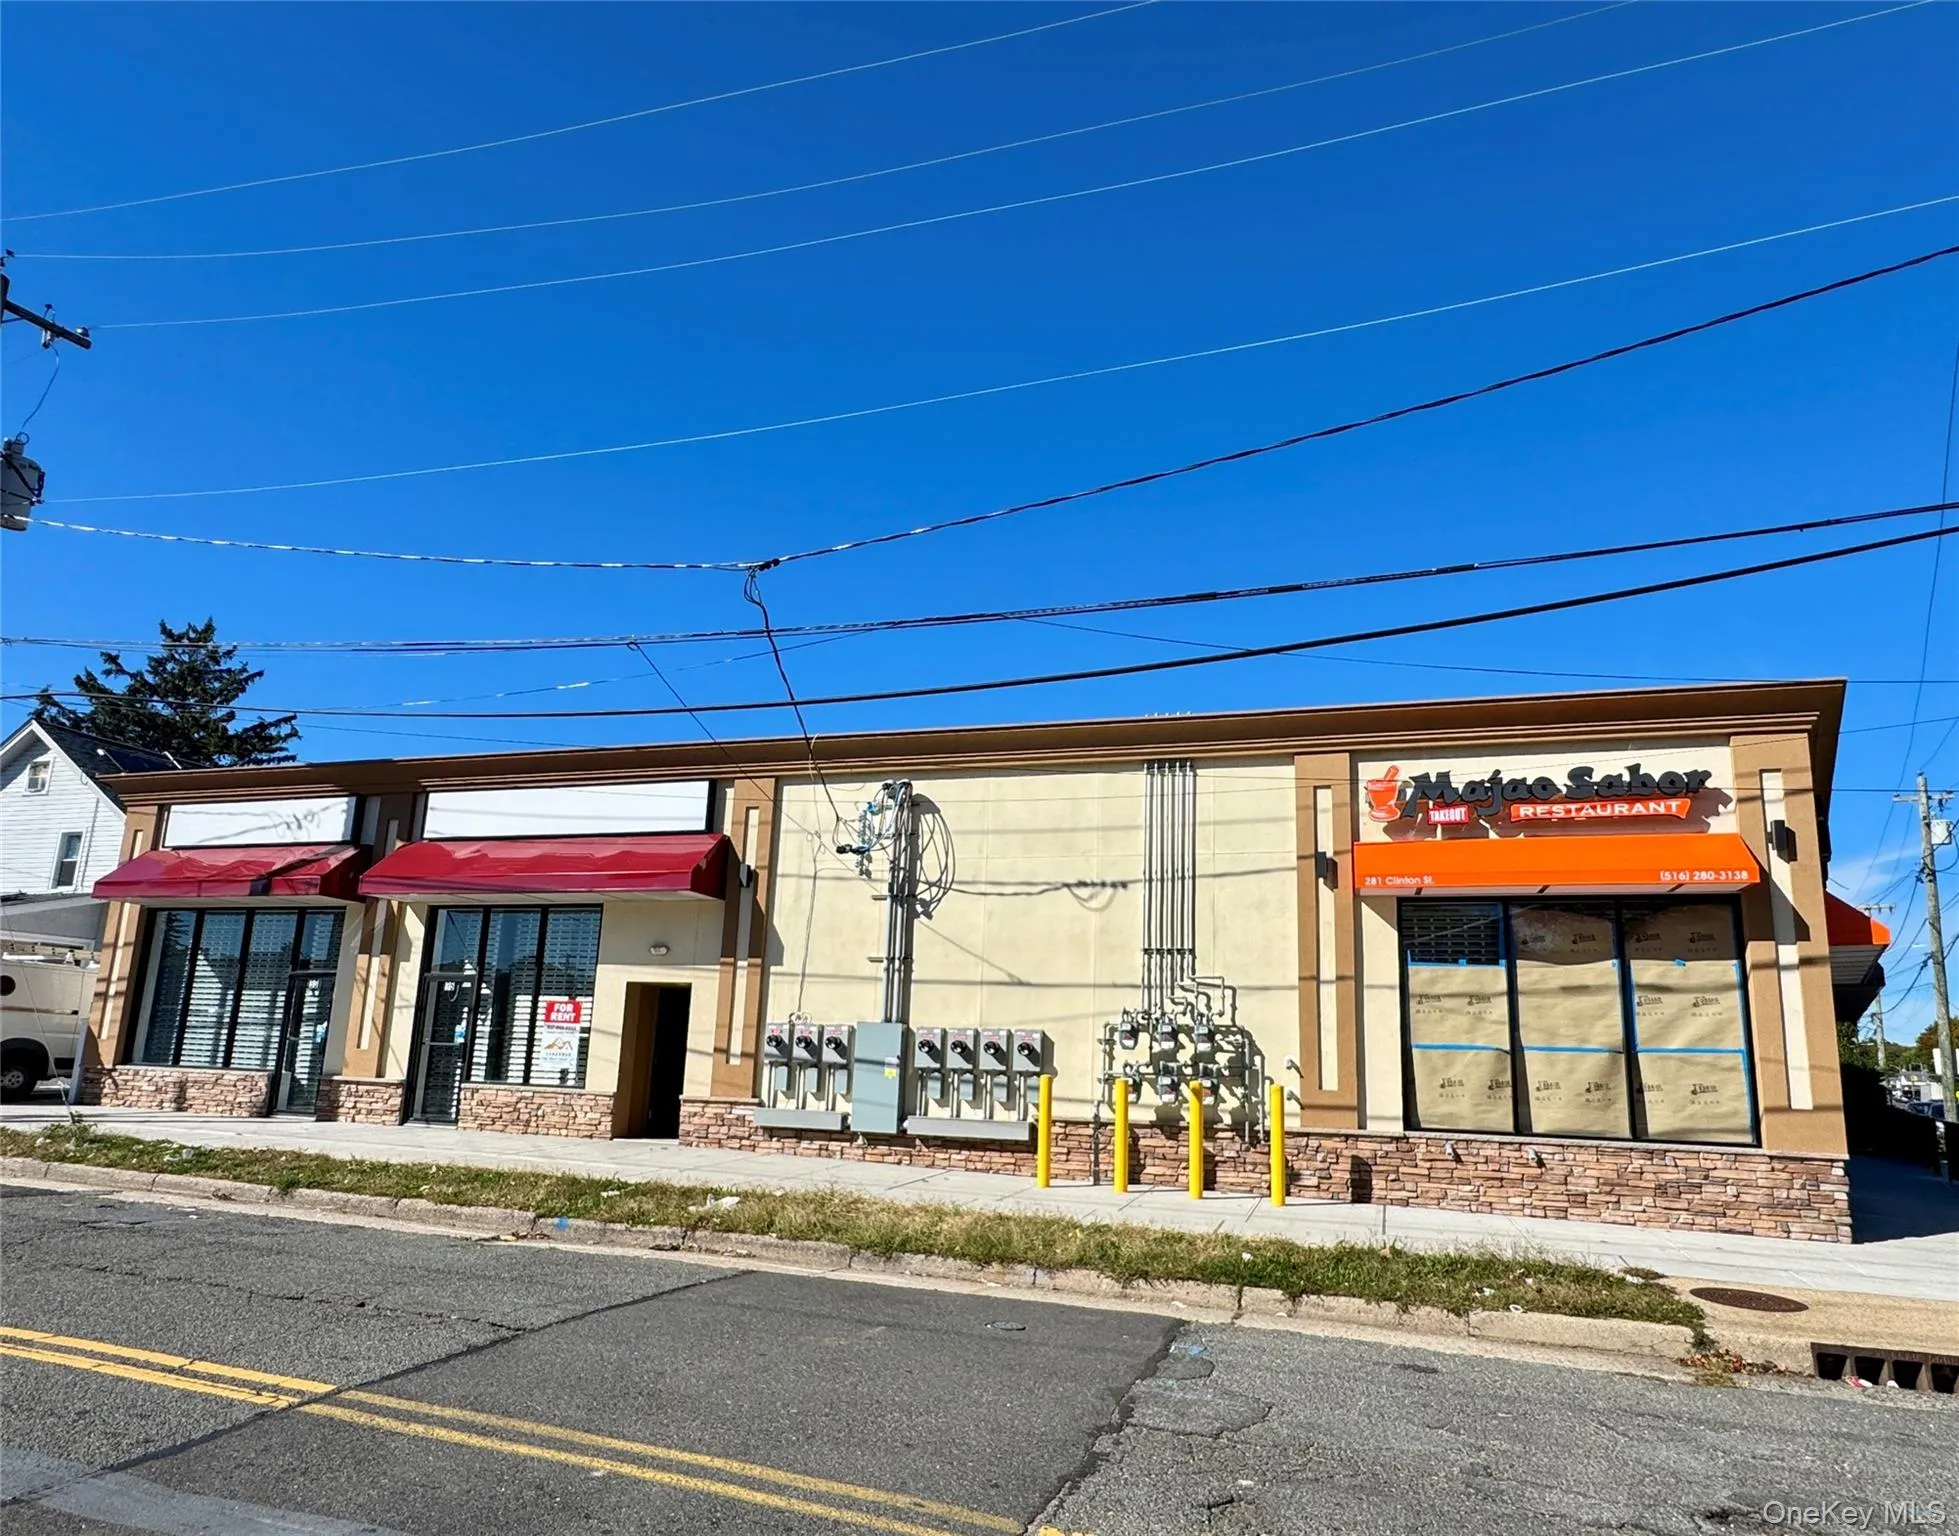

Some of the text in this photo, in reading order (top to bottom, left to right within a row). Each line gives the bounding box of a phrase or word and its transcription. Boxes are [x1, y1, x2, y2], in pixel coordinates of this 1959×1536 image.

[1401, 762, 1713, 818] Majao Sabor
[1429, 807, 1466, 822] TAKEOUT
[1519, 800, 1682, 818] RESTAURANT
[1364, 874, 1436, 886] 281 Clinton St.
[1660, 869, 1749, 881] (516) 280-3138
[553, 1003, 574, 1013] FOR
[550, 1011, 576, 1022] RENT
